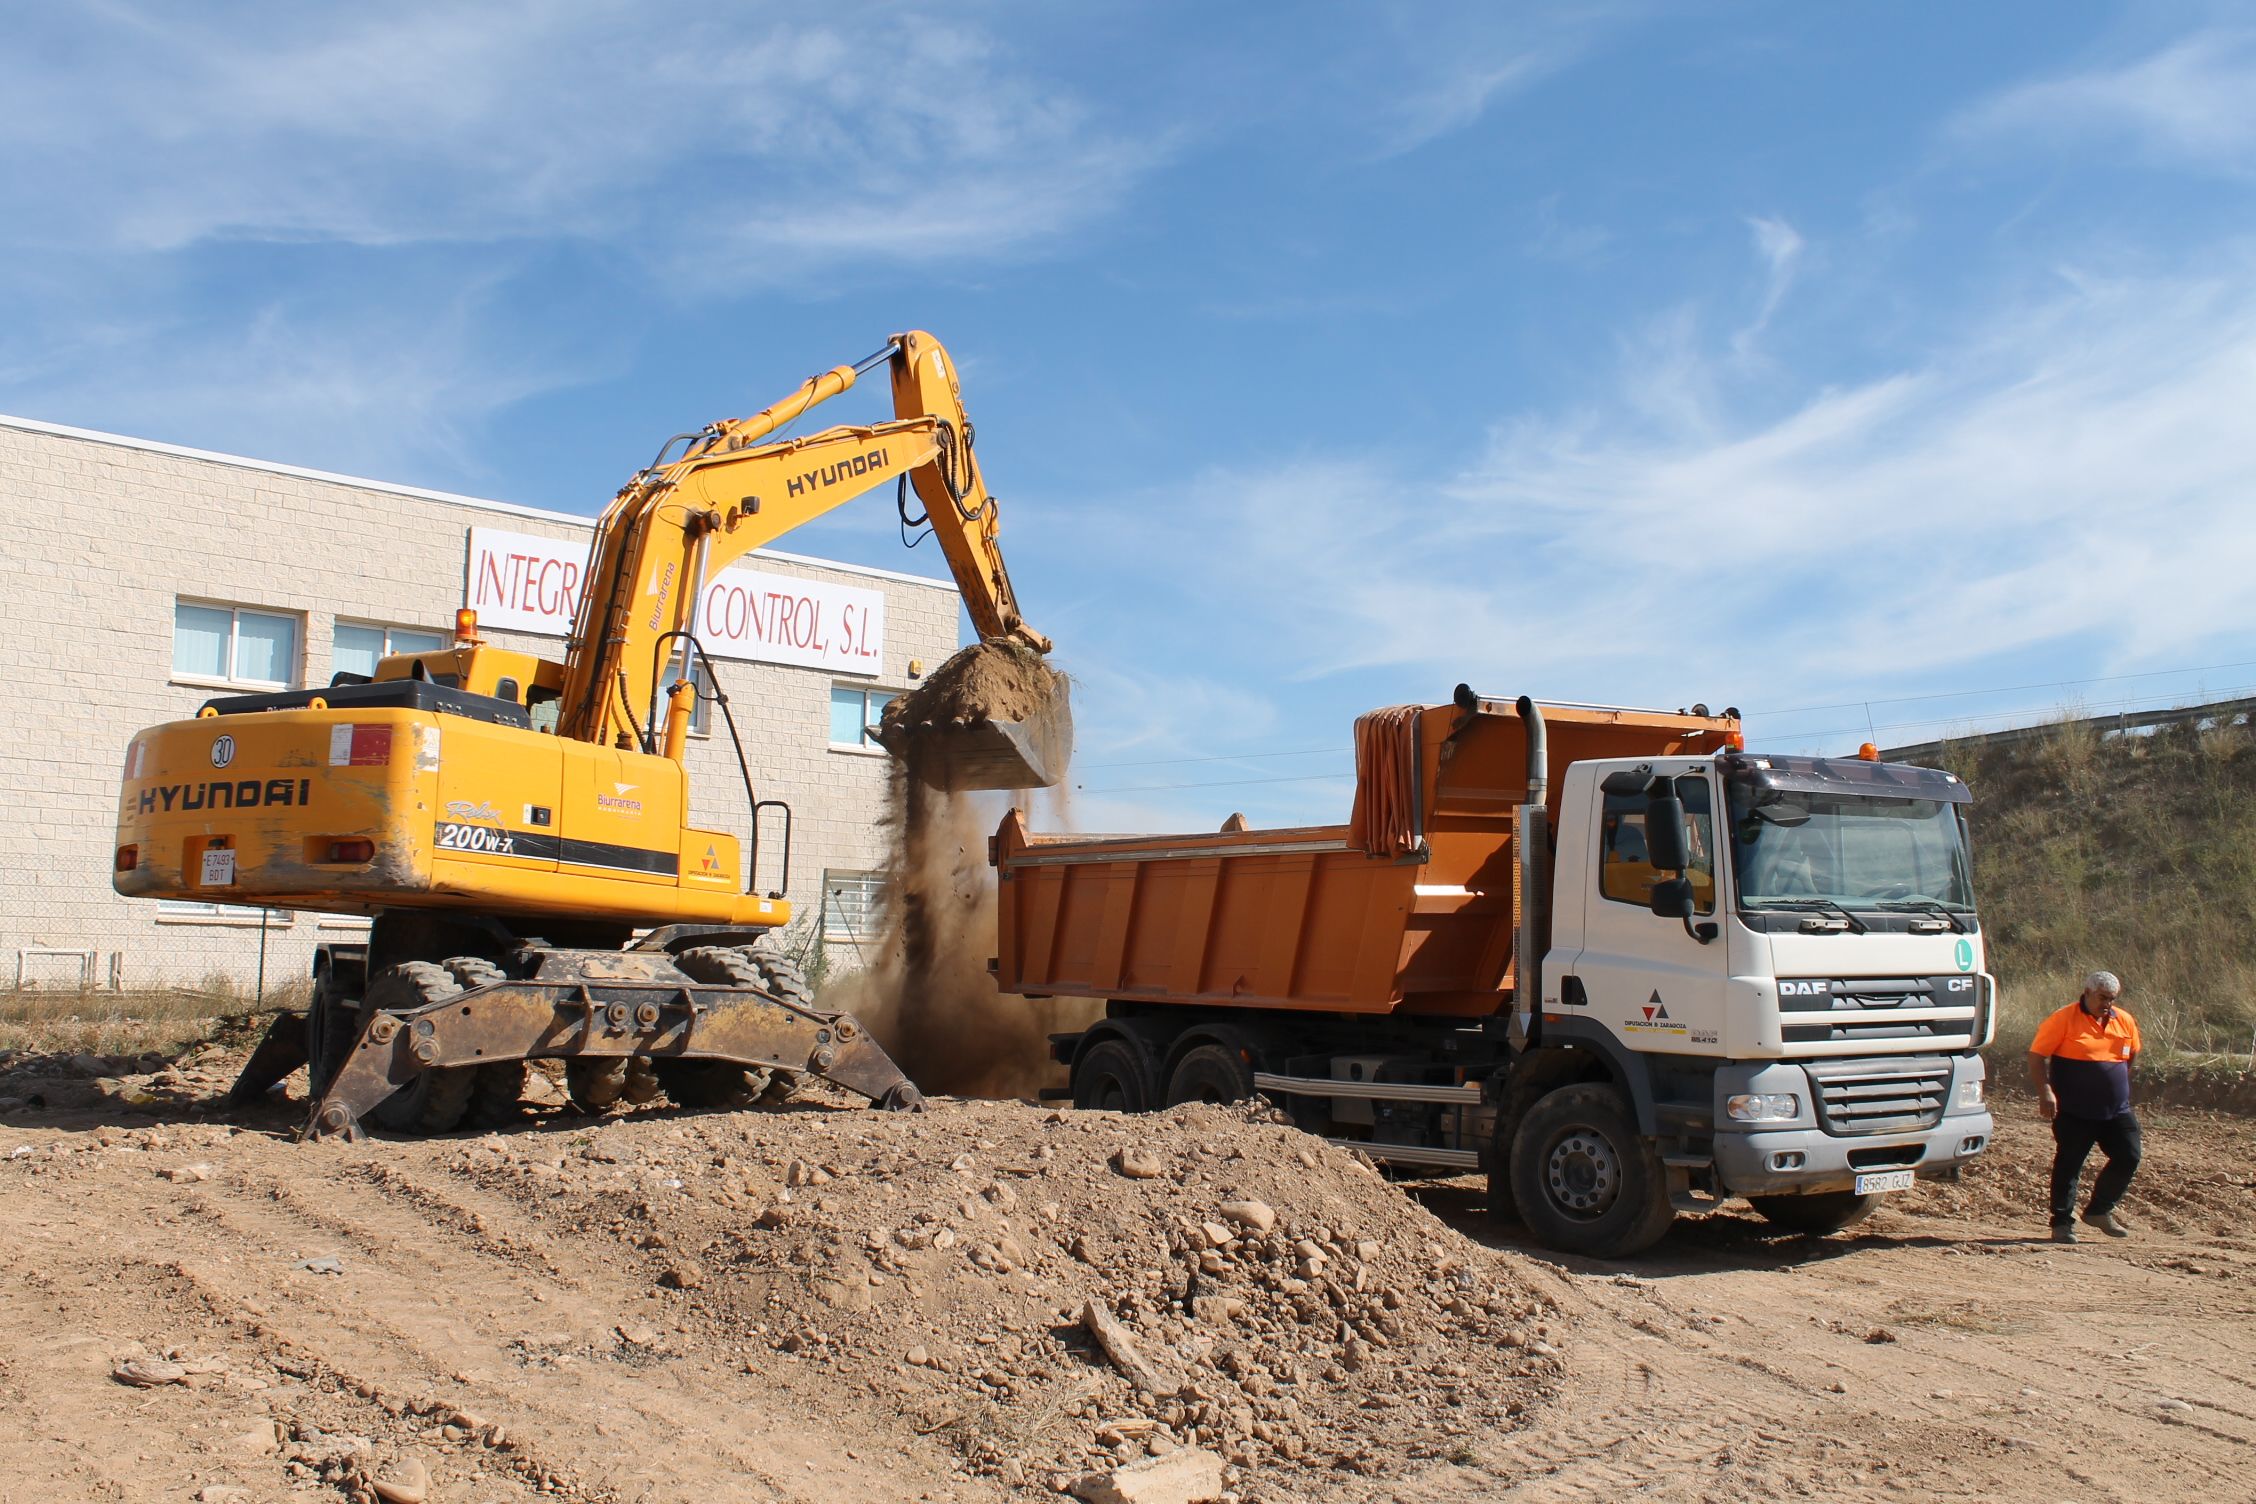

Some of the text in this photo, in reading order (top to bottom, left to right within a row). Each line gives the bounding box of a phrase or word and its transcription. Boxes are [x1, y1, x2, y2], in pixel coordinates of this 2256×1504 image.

[787, 448, 890, 498] HYUNDAI
[476, 549, 878, 658] INTEGR CONTROL, S.L.
[648, 561, 675, 632] Biurrarena
[213, 737, 232, 765] 30
[138, 779, 310, 815] HYUNDAI
[597, 793, 642, 811] Biurrarena
[1957, 943, 1969, 966] L
[1778, 981, 1828, 996] DAF
[1947, 978, 1974, 992] CF
